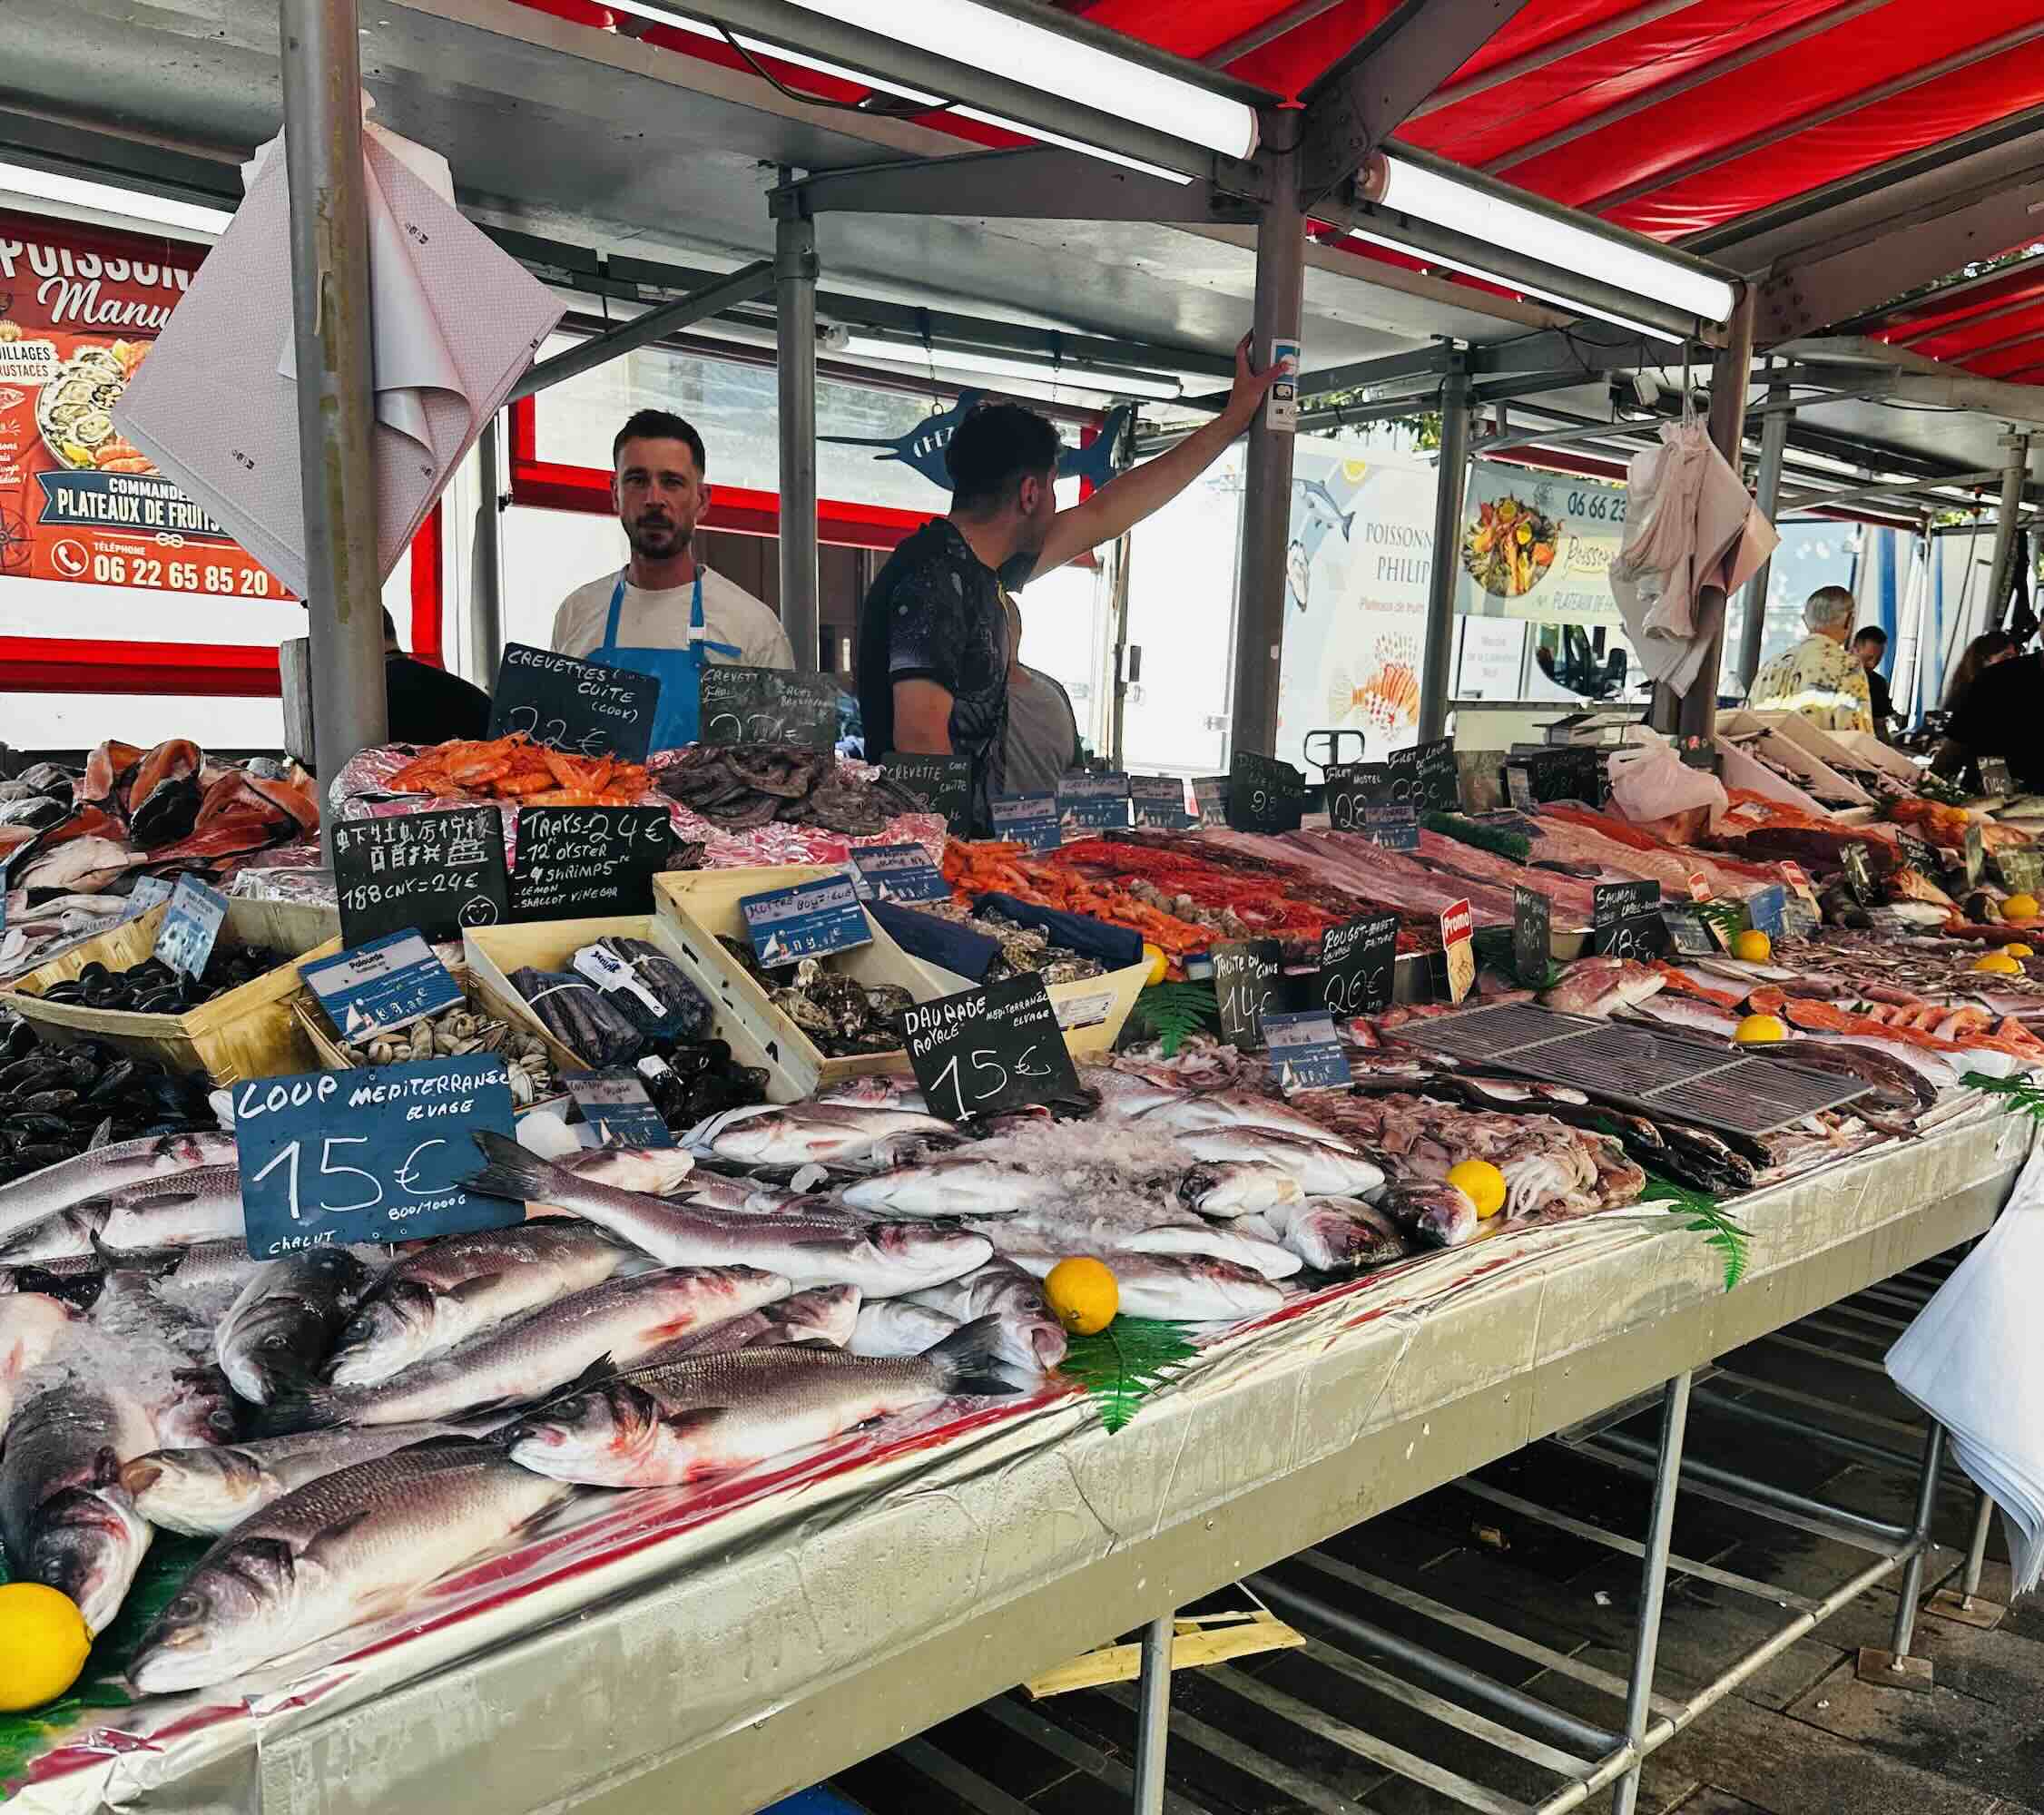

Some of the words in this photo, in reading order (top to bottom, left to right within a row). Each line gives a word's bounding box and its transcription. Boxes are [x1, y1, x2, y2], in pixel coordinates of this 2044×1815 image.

[58, 487, 141, 524] PLATEAUX
[144, 500, 165, 526] DE
[1567, 491, 1585, 516] 06
[1588, 495, 1606, 520] 66
[94, 542, 146, 555] TÉLÉPHONE
[94, 554, 125, 584] 06
[133, 559, 162, 587] 22
[169, 562, 199, 590] 65
[205, 564, 233, 594] 85
[240, 569, 268, 596] 20
[507, 650, 606, 682] CREVETTES
[1444, 912, 1469, 937] Promo
[905, 996, 987, 1035] DAURADE
[913, 1023, 960, 1058] ROYALE
[237, 1074, 339, 1120] LOUP
